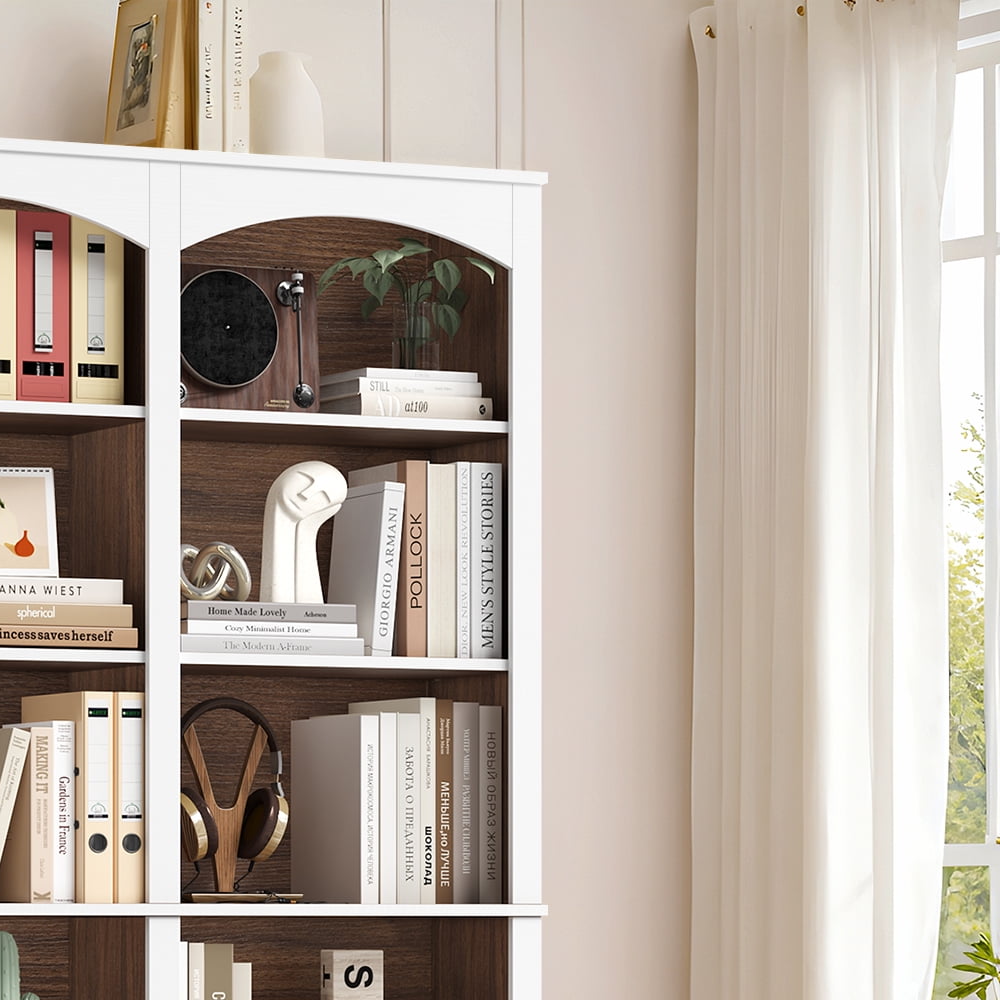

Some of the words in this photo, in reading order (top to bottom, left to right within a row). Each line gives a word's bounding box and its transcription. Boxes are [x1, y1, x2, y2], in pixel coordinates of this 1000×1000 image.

[369, 380, 390, 392] STILL
[460, 467, 468, 548] REVOLUTION
[480, 471, 494, 541] STORIES
[384, 507, 398, 568] ARMANI
[409, 512, 423, 609] POLLOCK
[460, 552, 468, 586] LOOK
[480, 545, 494, 595] STYLE
[43, 585, 83, 596] WIEST
[378, 572, 394, 638] GIORGIO
[460, 589, 468, 619] NEW
[16, 604, 56, 620] spherical
[208, 607, 232, 616] Home
[234, 607, 258, 616] Made
[259, 607, 287, 619] Lovely
[246, 625, 285, 633] Minimalist
[480, 599, 494, 649] MEN'S
[223, 641, 240, 650] The
[242, 641, 275, 650] Modern
[35, 735, 49, 780] MAKING
[405, 746, 414, 791] ЗАБОТА
[486, 731, 498, 780] НОВЫЙ
[35, 783, 49, 794] IT
[58, 776, 71, 813] Gardens
[405, 795, 414, 805] О
[486, 785, 497, 827] ОБРАЗ
[59, 814, 70, 823] in
[58, 825, 70, 855] France
[404, 807, 414, 882] ПРЕДАННЫХ
[423, 826, 432, 886] ШОКОЛАД
[486, 831, 497, 881] ЖИЗНИ
[440, 848, 450, 887] ЛУЧШЕ
[343, 964, 374, 989] S
